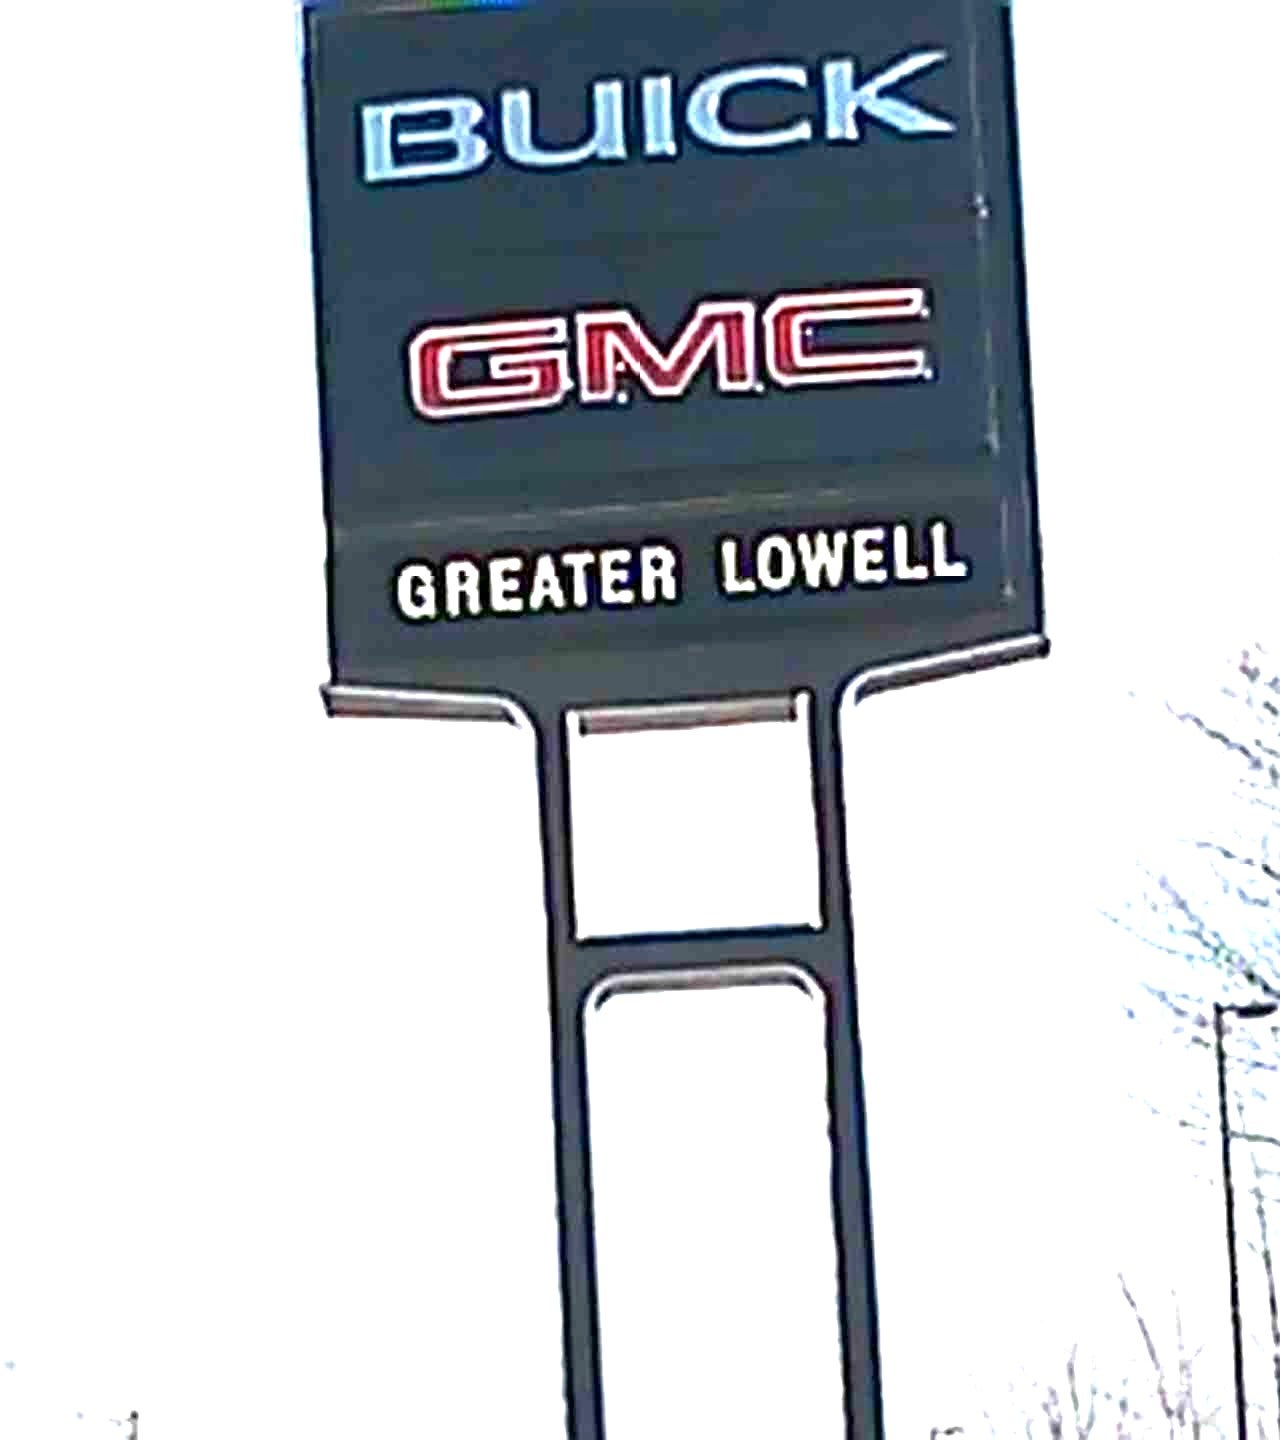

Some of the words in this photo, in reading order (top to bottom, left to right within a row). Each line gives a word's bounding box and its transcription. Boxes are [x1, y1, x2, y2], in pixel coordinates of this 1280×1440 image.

[361, 50, 956, 182] BUICK
[408, 286, 933, 418] GMC
[396, 545, 676, 619] GREATER
[721, 521, 967, 593] LOWELL
